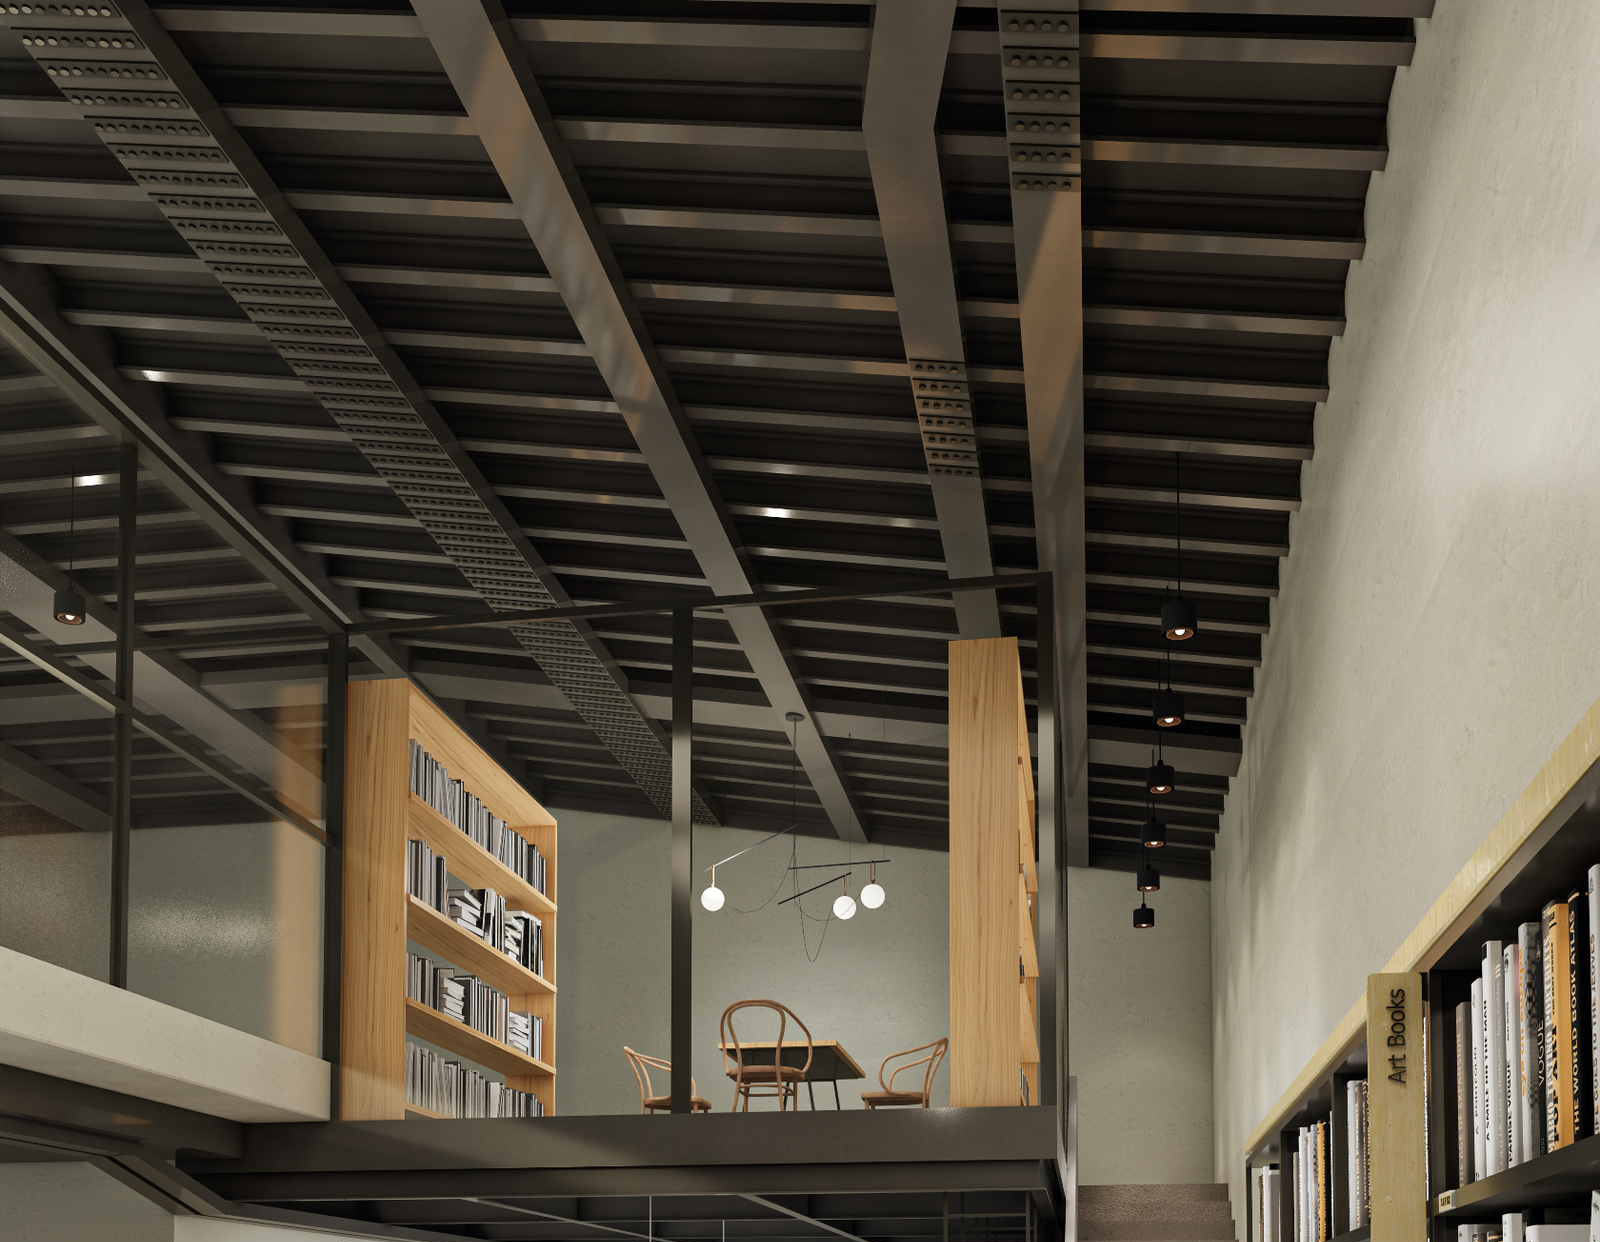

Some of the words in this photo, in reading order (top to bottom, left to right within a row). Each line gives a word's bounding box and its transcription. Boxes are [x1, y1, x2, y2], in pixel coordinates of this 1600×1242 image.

[1387, 988, 1406, 1051] Books
[1388, 1055, 1406, 1084] Art
[1537, 1020, 1545, 1086] VOGUE
[1571, 1027, 1579, 1094] WORLD
